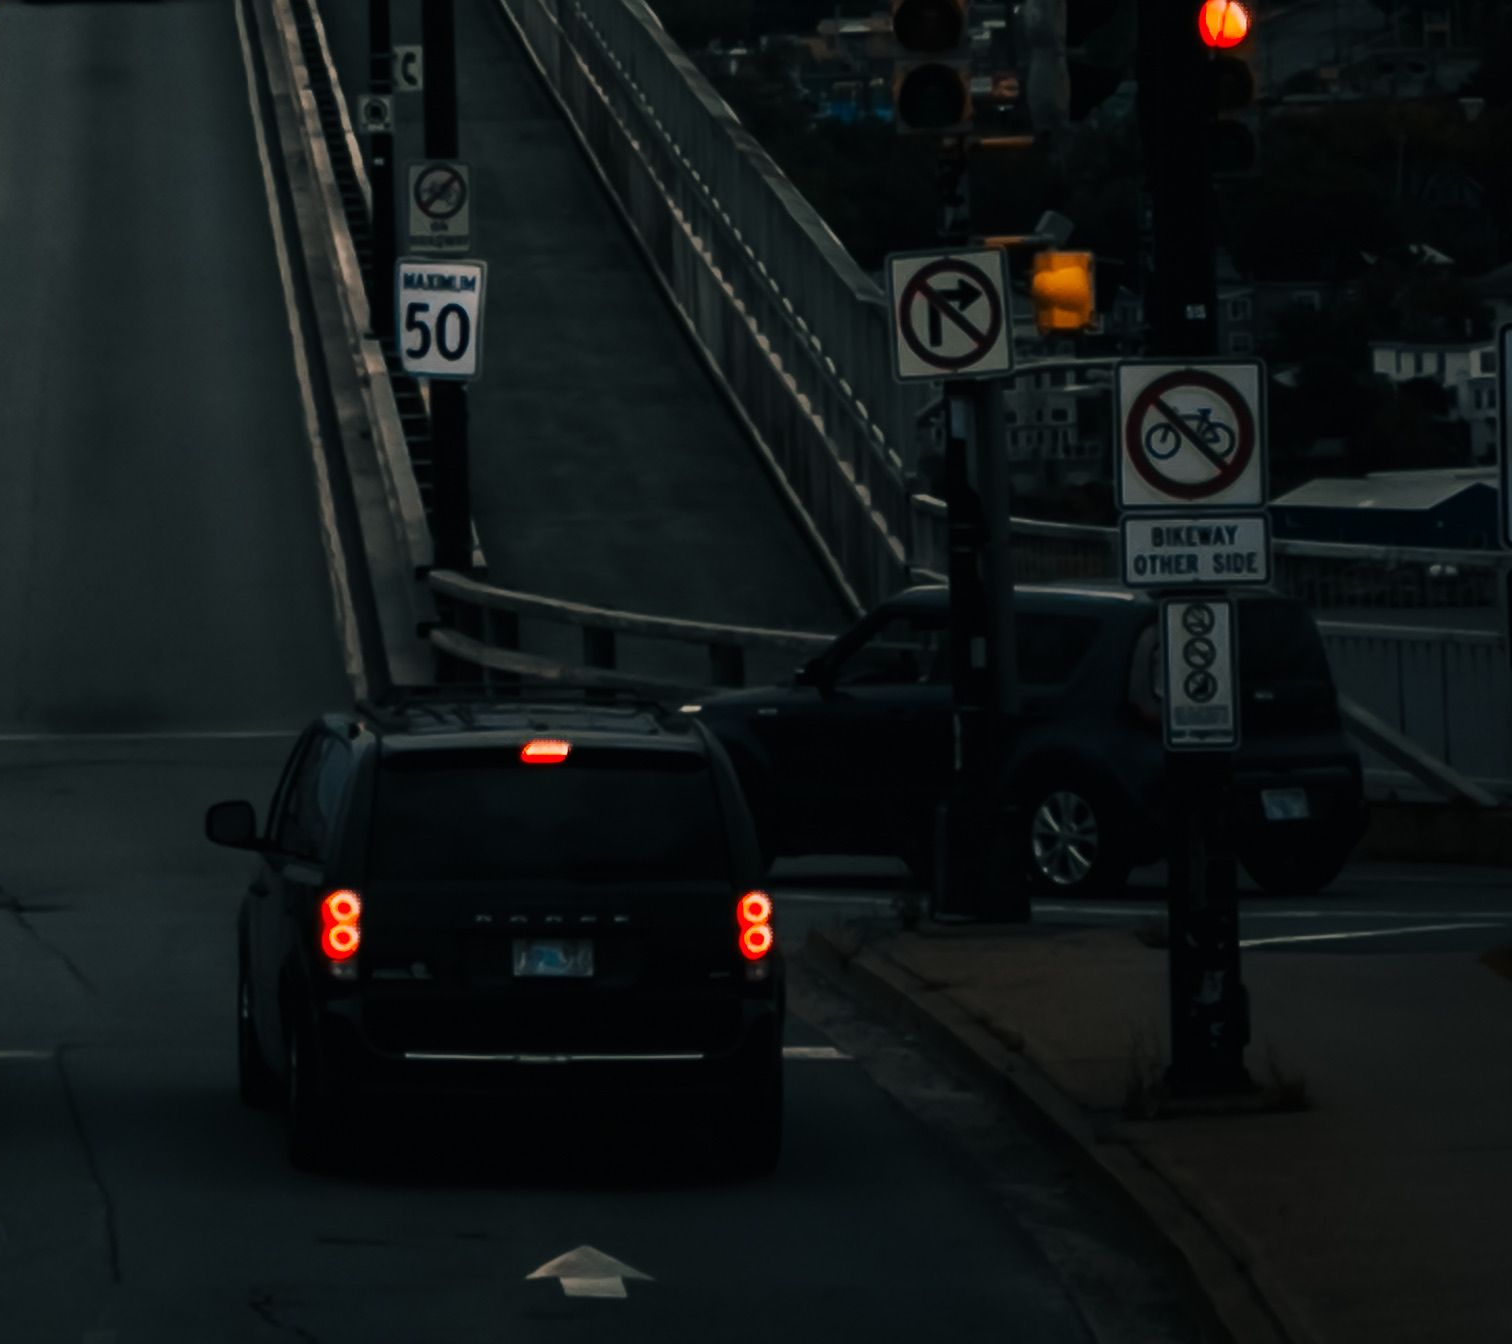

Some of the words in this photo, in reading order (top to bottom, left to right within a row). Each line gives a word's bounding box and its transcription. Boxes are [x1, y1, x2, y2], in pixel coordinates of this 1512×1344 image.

[403, 272, 476, 291] MAXIMUM
[405, 302, 470, 361] 50
[1152, 525, 1238, 547] BIKEWAY
[1134, 553, 1199, 576] OTHER
[1213, 552, 1258, 574] SIDE
